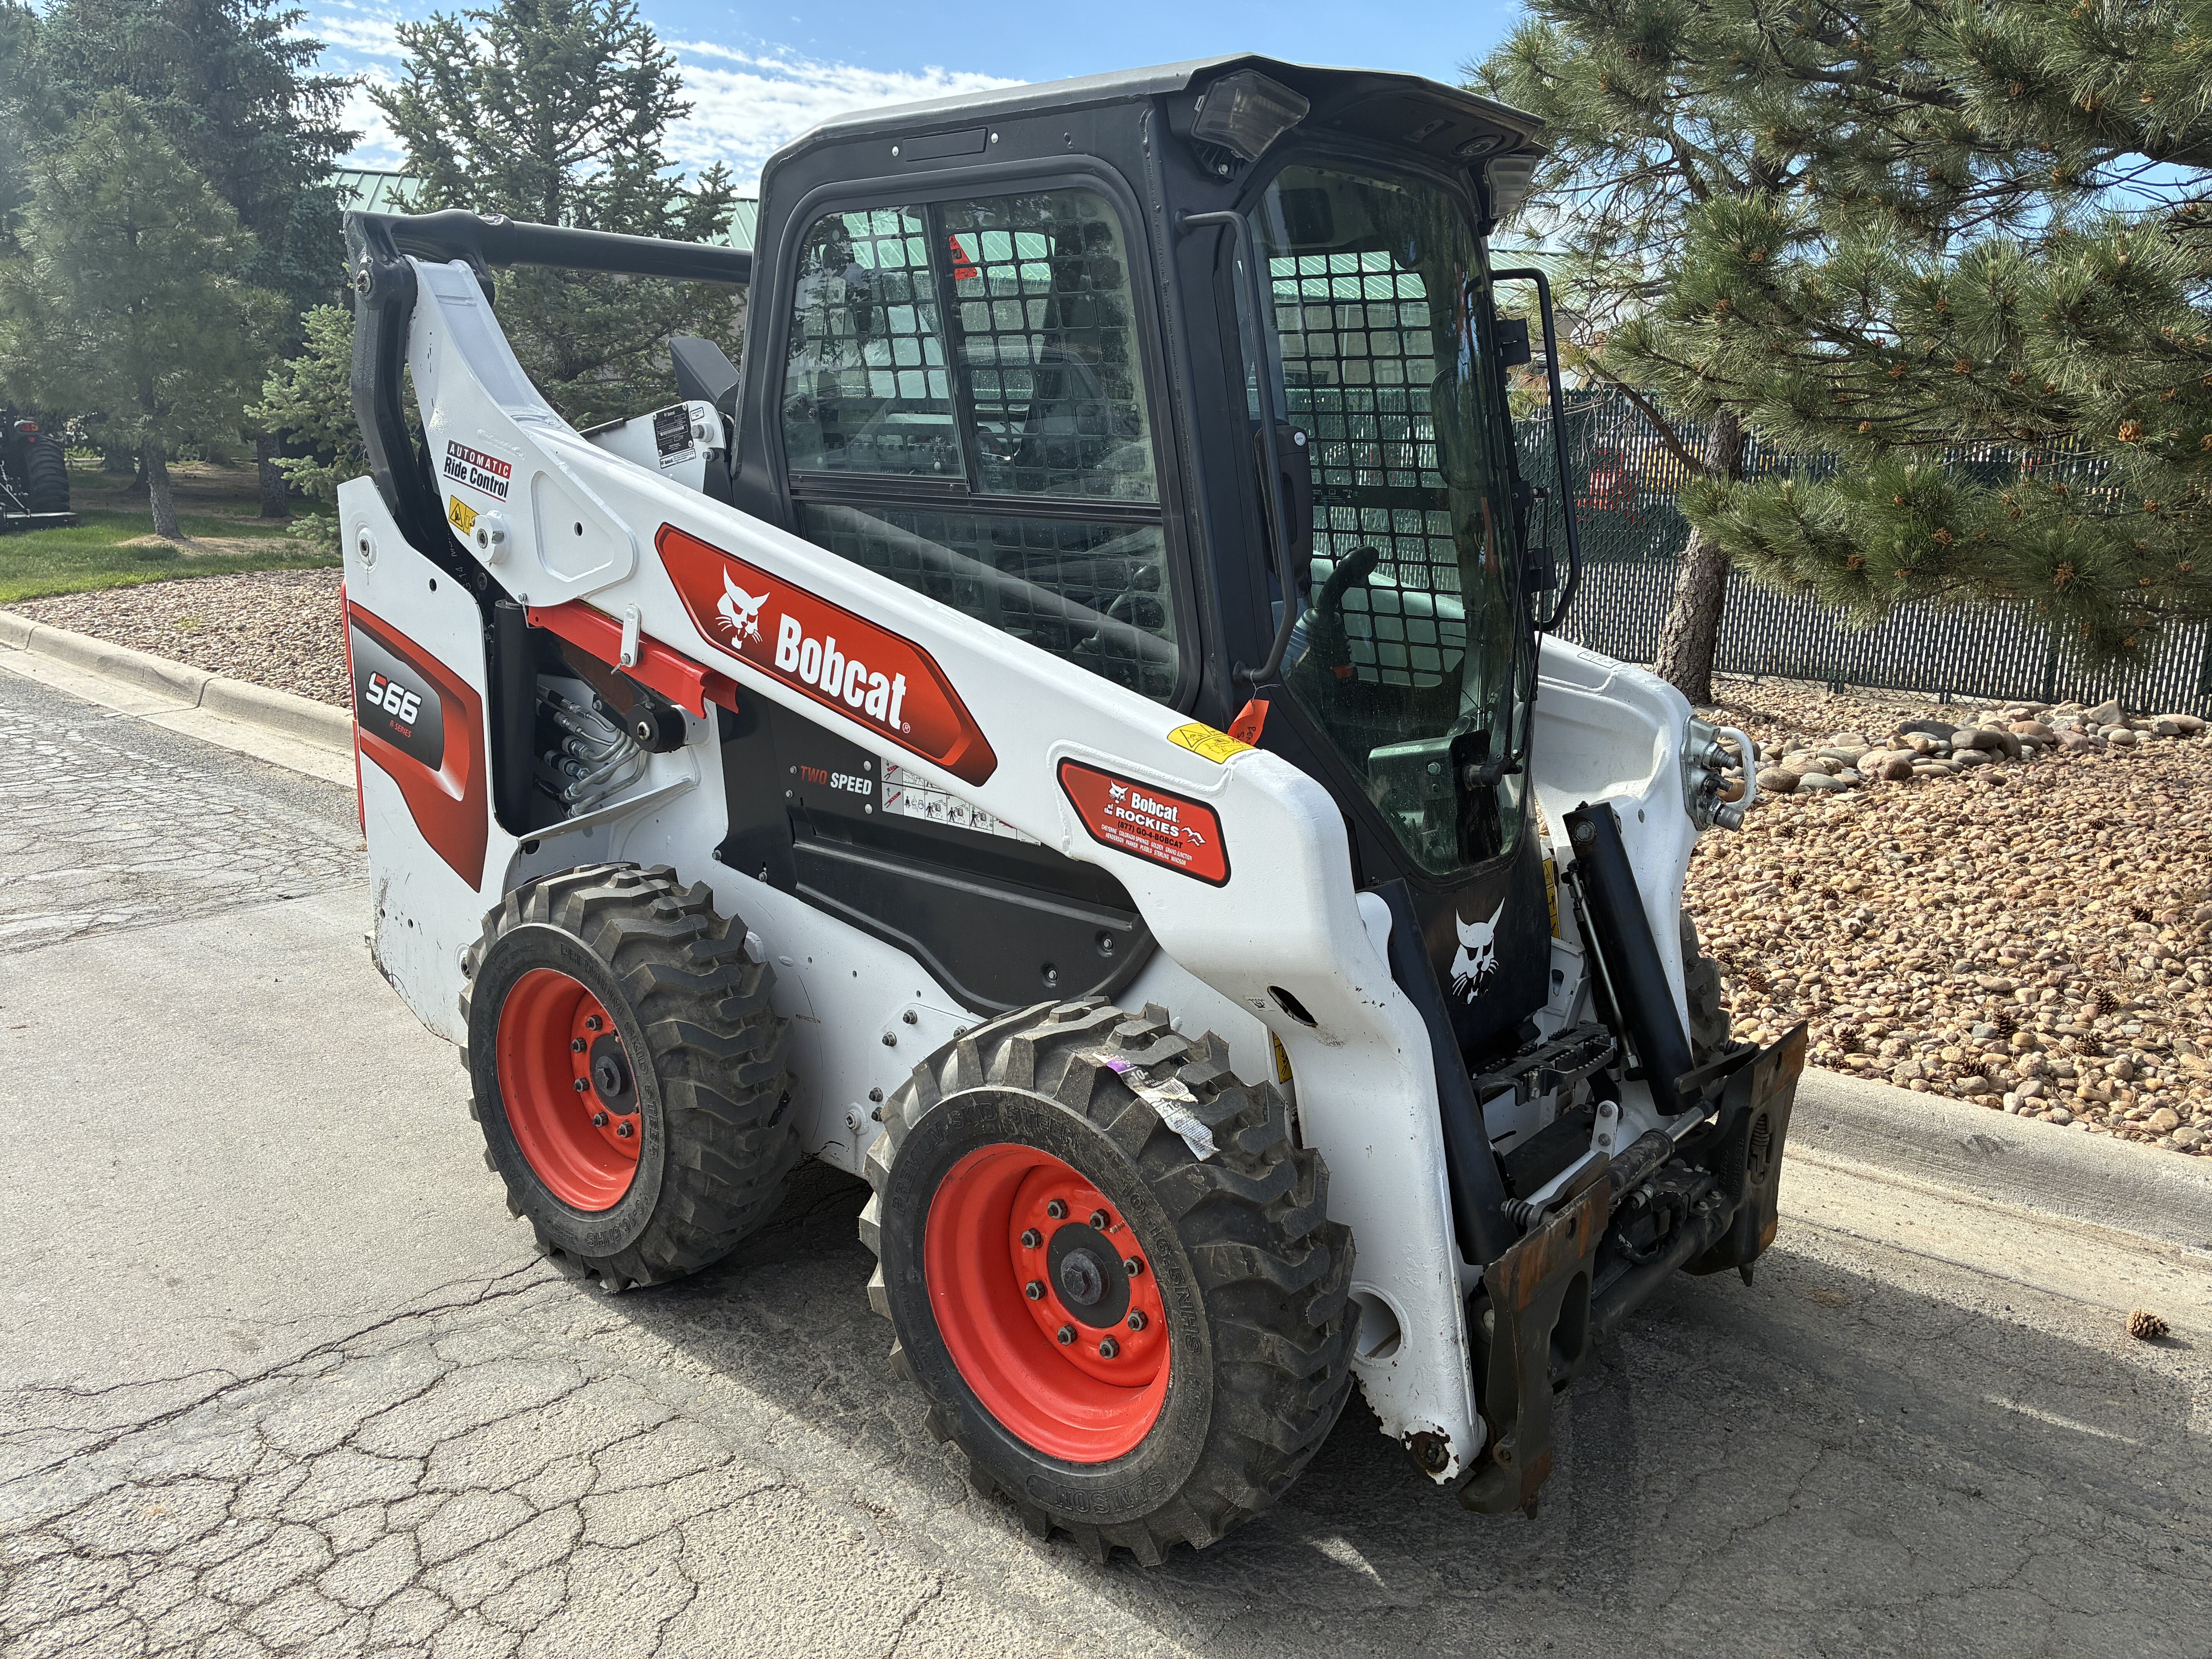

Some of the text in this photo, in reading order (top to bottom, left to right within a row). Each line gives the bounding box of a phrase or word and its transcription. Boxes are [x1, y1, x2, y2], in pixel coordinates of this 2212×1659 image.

[449, 443, 510, 476] AUTOMATIC
[444, 456, 509, 498] Ride Control
[775, 612, 907, 730] Bobcat
[366, 672, 422, 725] S66
[389, 720, 412, 738] R-SERIES
[800, 765, 872, 795] TWO SPEED
[1104, 805, 1113, 816] the
[1116, 807, 1180, 837] ROCKIES
[1131, 792, 1178, 823] Bobcat
[1101, 824, 1192, 861] CHEYENNE COLORADO SPRINGS GOLDEN GRAND JUNCTION
[1105, 832, 1186, 866] HENDERSON PARKER PUEBLO STERLING WINDSOR
[1118, 821, 1183, 849] (877) GO-4-BOBCAT
[624, 1020, 648, 1074] SKID
[644, 1084, 658, 1159] STEER
[949, 1102, 998, 1130] SKID
[1055, 1469, 1166, 1515] SAMSON
